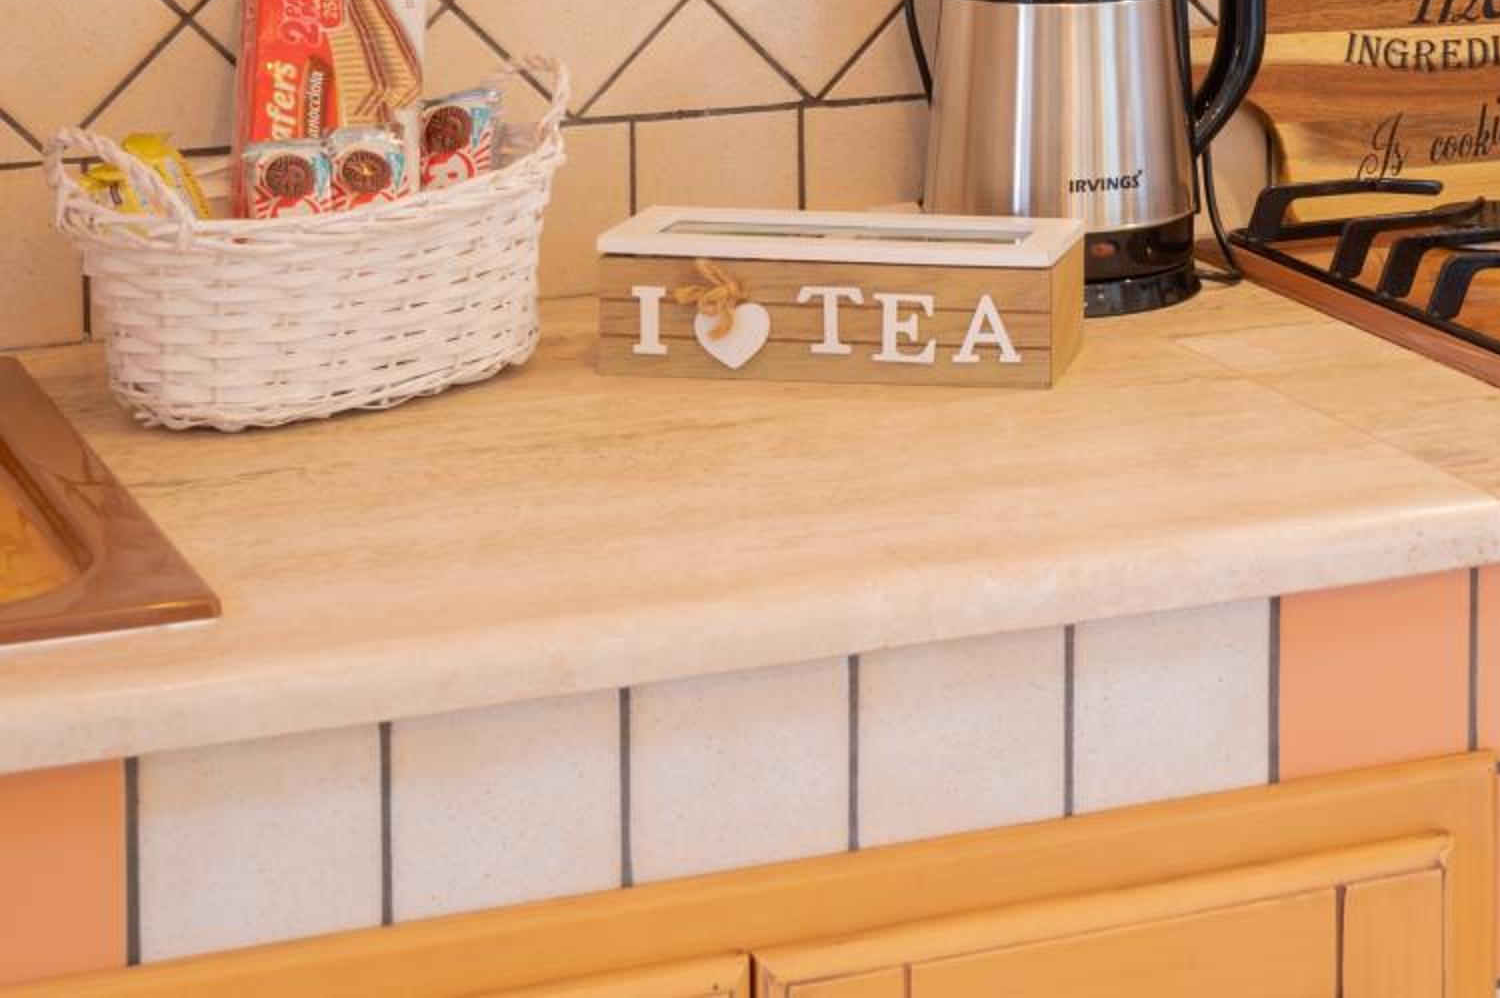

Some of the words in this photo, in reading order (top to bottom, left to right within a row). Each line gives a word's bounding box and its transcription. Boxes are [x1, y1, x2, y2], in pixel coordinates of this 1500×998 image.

[265, 58, 297, 141] afers
[1068, 173, 1140, 194] IRVINGS
[1357, 111, 1408, 181] Is
[630, 284, 668, 356] I
[796, 284, 1024, 364] TEA
